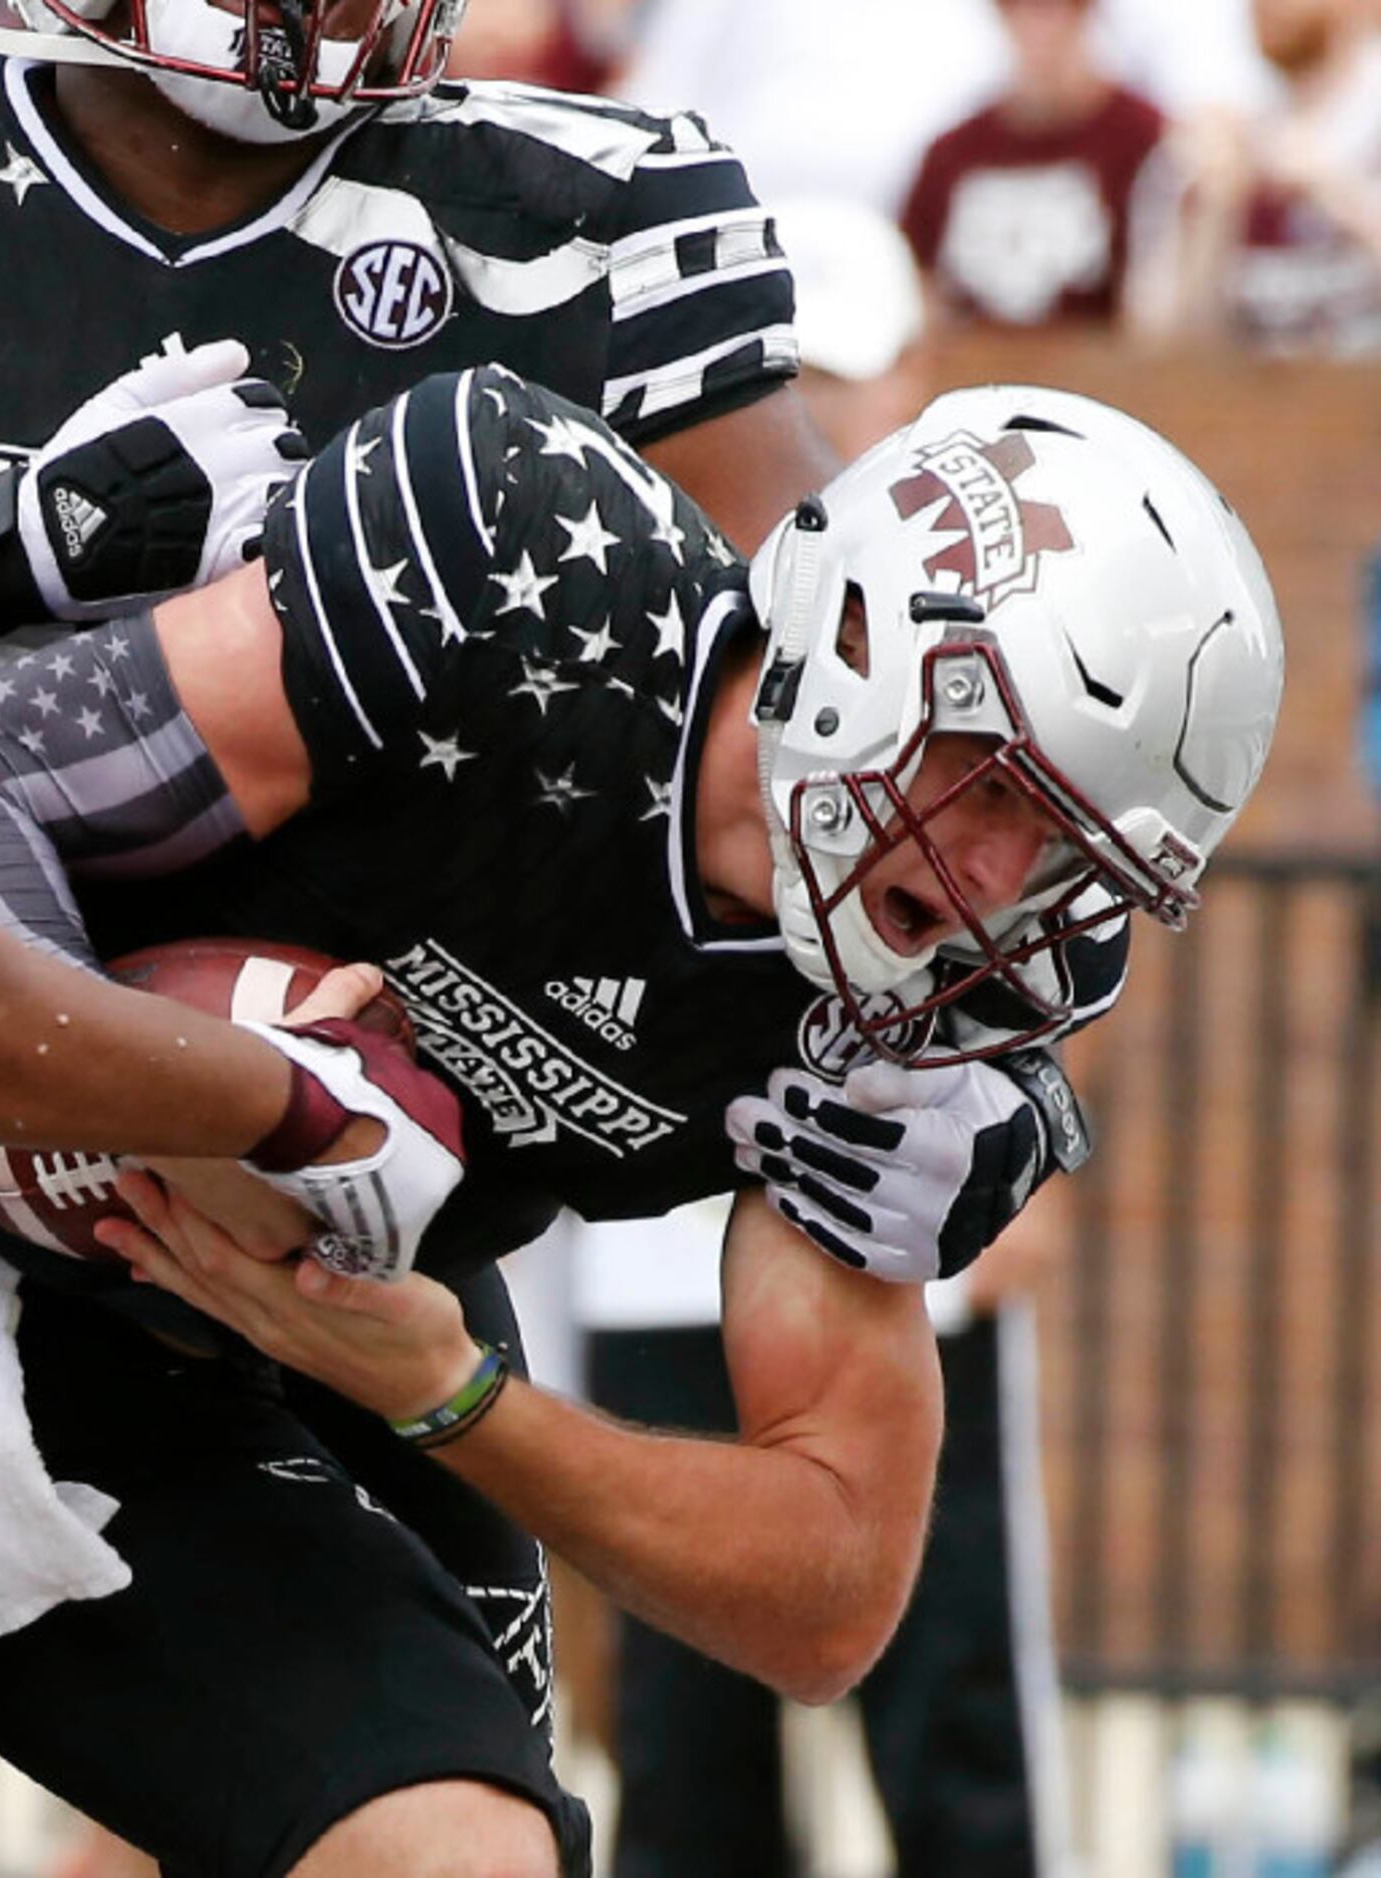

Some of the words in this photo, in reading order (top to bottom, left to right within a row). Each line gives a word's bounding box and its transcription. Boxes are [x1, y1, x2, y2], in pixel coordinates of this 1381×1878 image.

[345, 244, 441, 340] SEC
[54, 487, 83, 558] adidas
[939, 454, 1016, 571] STATE
[387, 944, 675, 1150] MISSISSIPPI
[544, 980, 638, 1051] adidas
